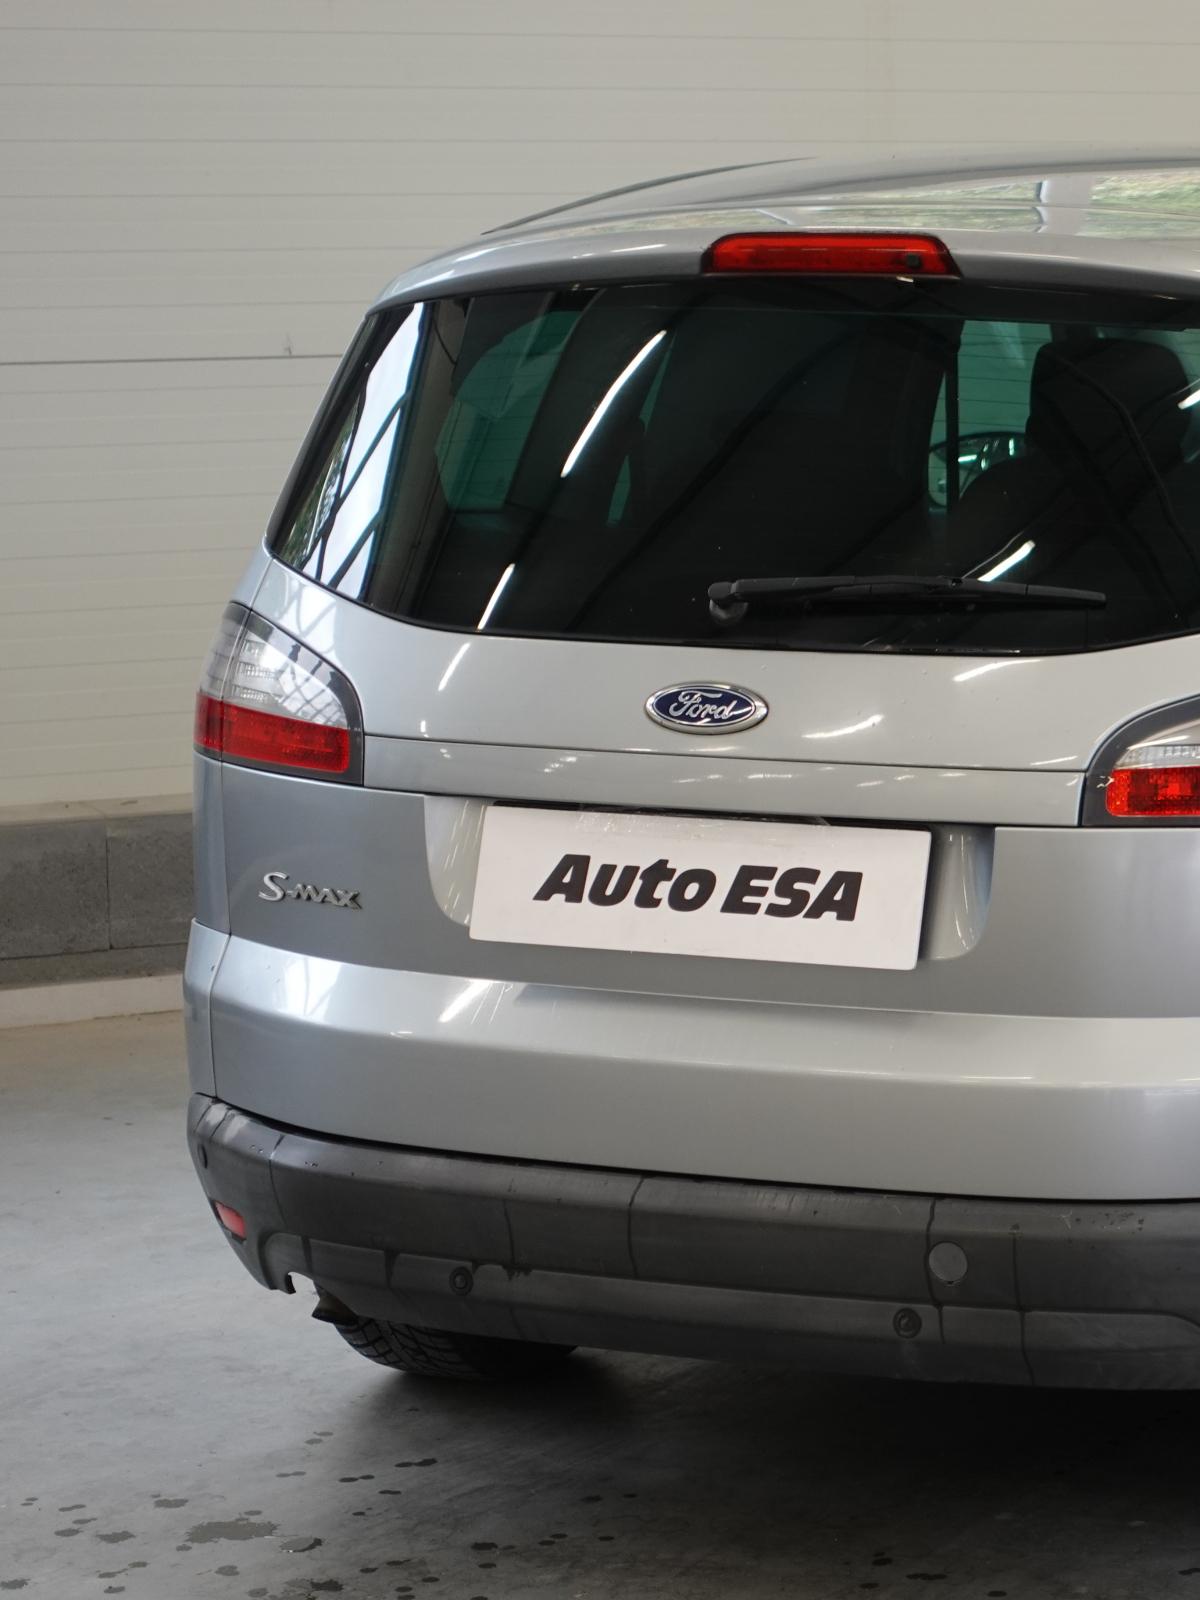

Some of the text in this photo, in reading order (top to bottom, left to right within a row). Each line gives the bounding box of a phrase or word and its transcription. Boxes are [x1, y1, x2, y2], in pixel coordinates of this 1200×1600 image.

[668, 690, 744, 720] Ford
[532, 853, 864, 922] Auto ESA
